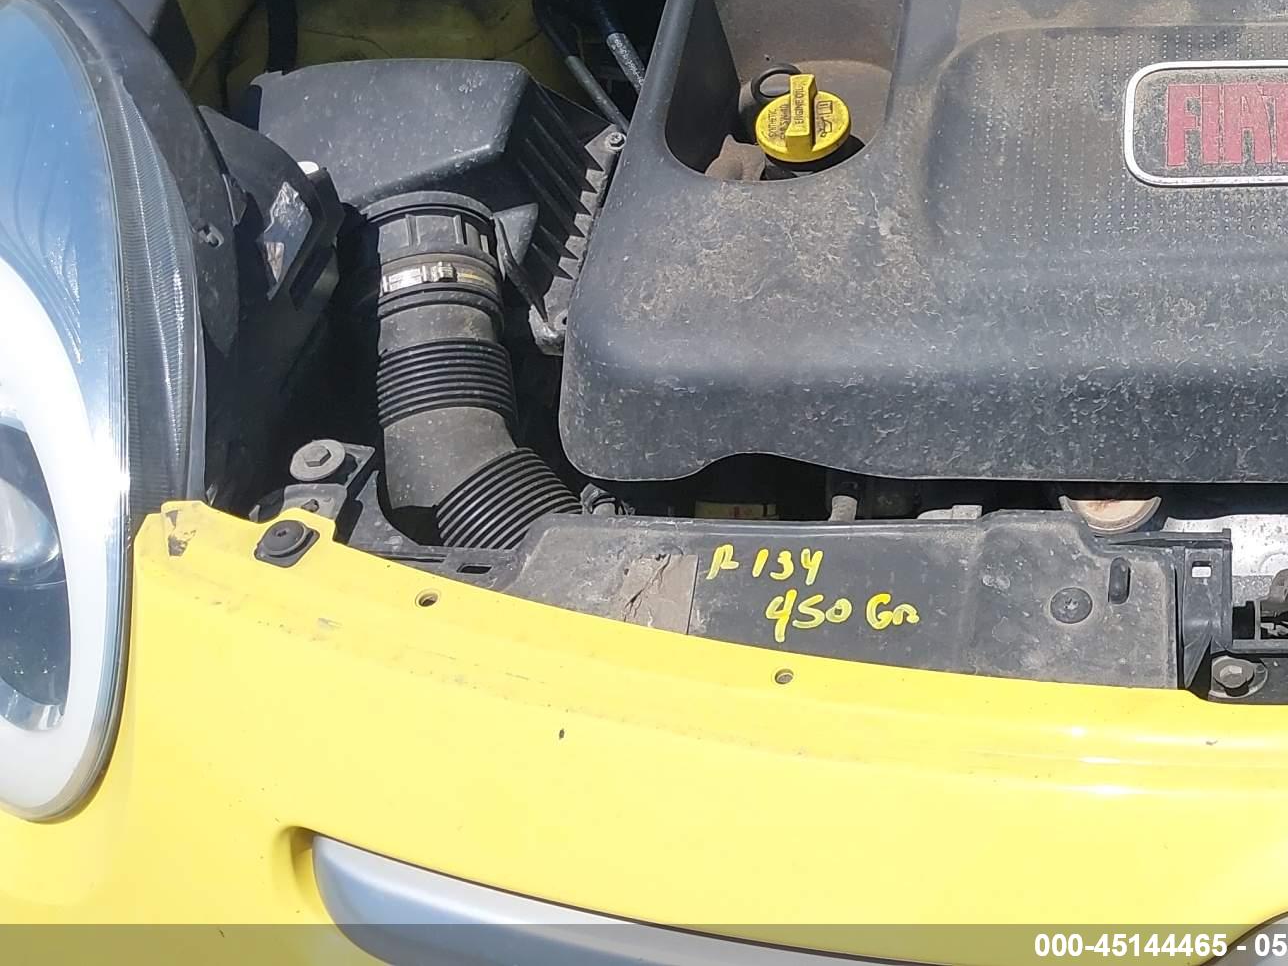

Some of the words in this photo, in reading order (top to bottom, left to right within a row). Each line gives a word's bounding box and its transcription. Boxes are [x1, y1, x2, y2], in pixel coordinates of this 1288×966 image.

[793, 86, 804, 99] OIL
[793, 99, 804, 125] ENGINE
[751, 547, 824, 586] 134
[765, 588, 853, 642] 450
